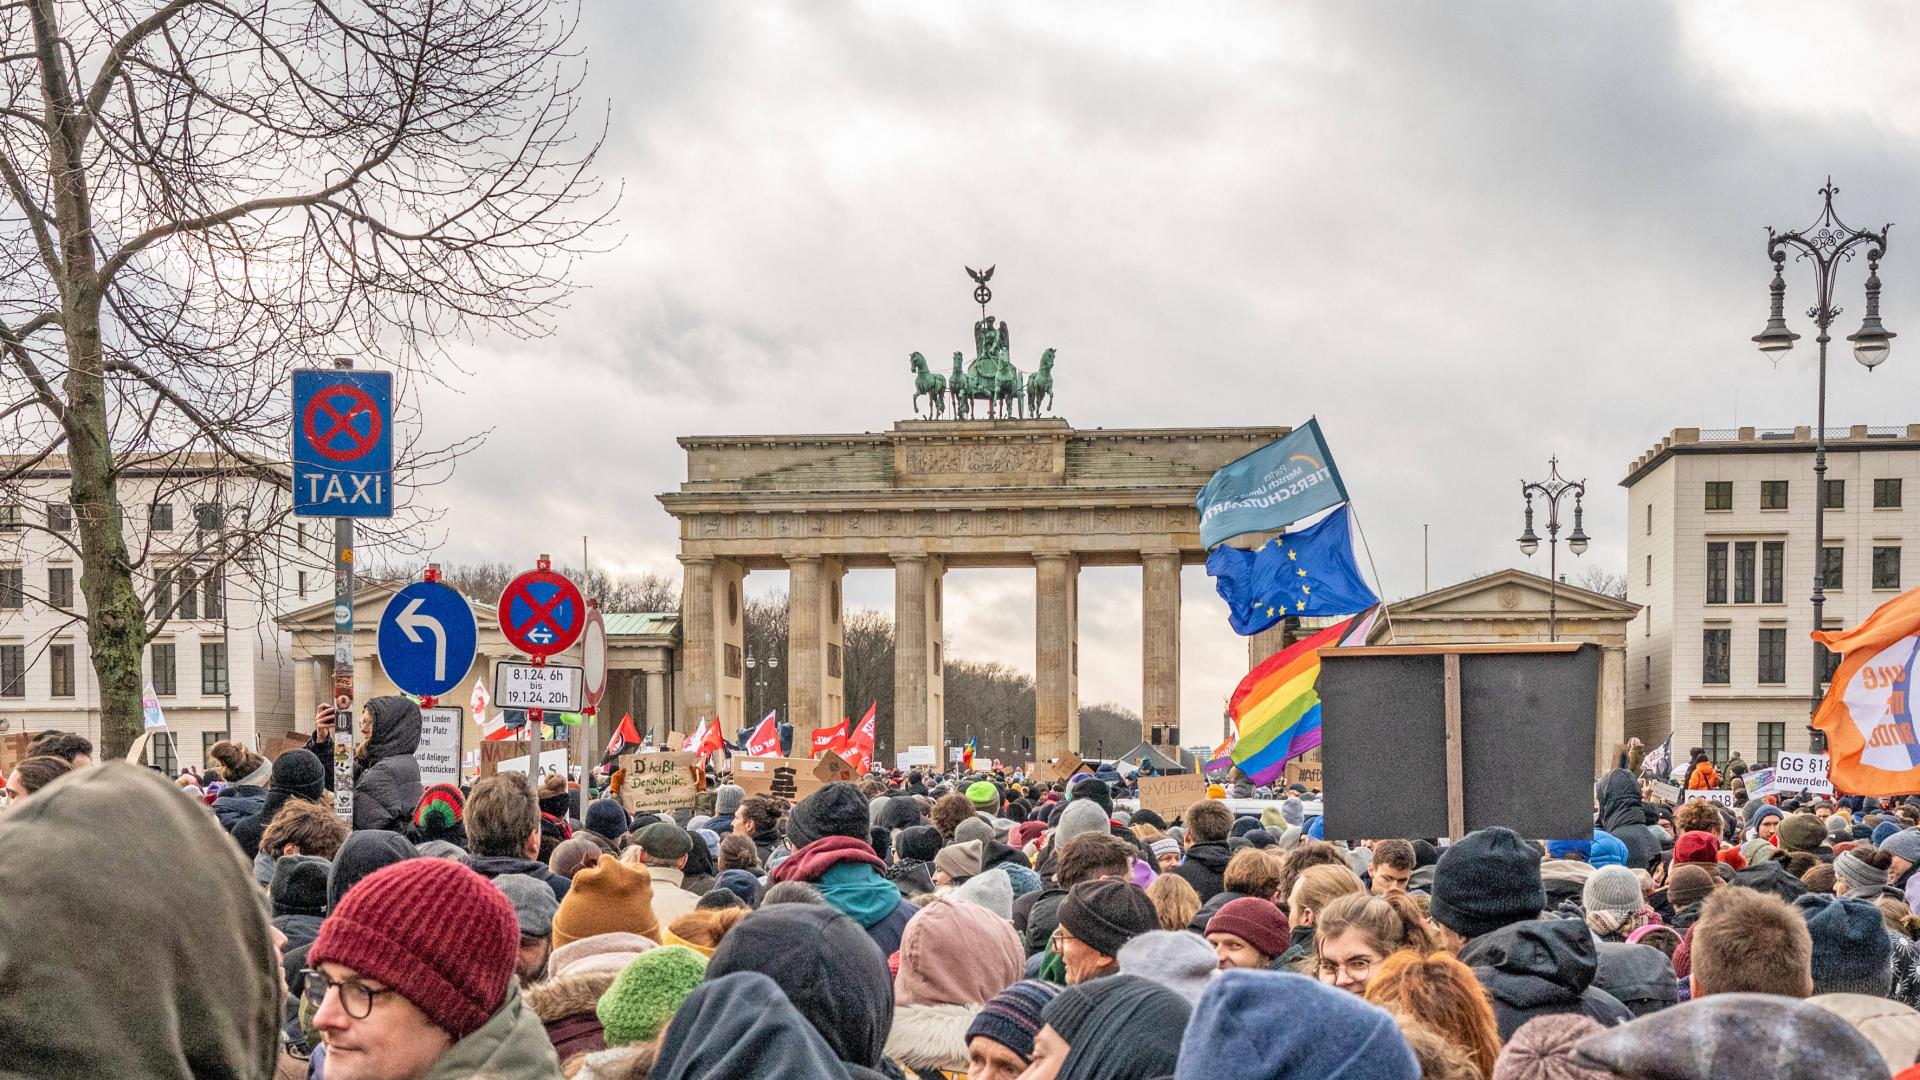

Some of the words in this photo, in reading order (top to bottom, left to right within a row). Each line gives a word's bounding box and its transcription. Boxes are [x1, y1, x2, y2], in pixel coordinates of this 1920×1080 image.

[303, 473, 382, 505] TAXI
[550, 670, 563, 681] 6h
[530, 682, 543, 690] bis
[548, 692, 568, 703] 20h
[431, 715, 451, 723] Linden
[433, 726, 448, 735] Platz
[426, 753, 451, 763] Anlieger
[649, 759, 676, 775] heißt
[1780, 757, 1804, 772] GG
[1808, 758, 1830, 773] §18
[1776, 775, 1828, 787] anwenden
